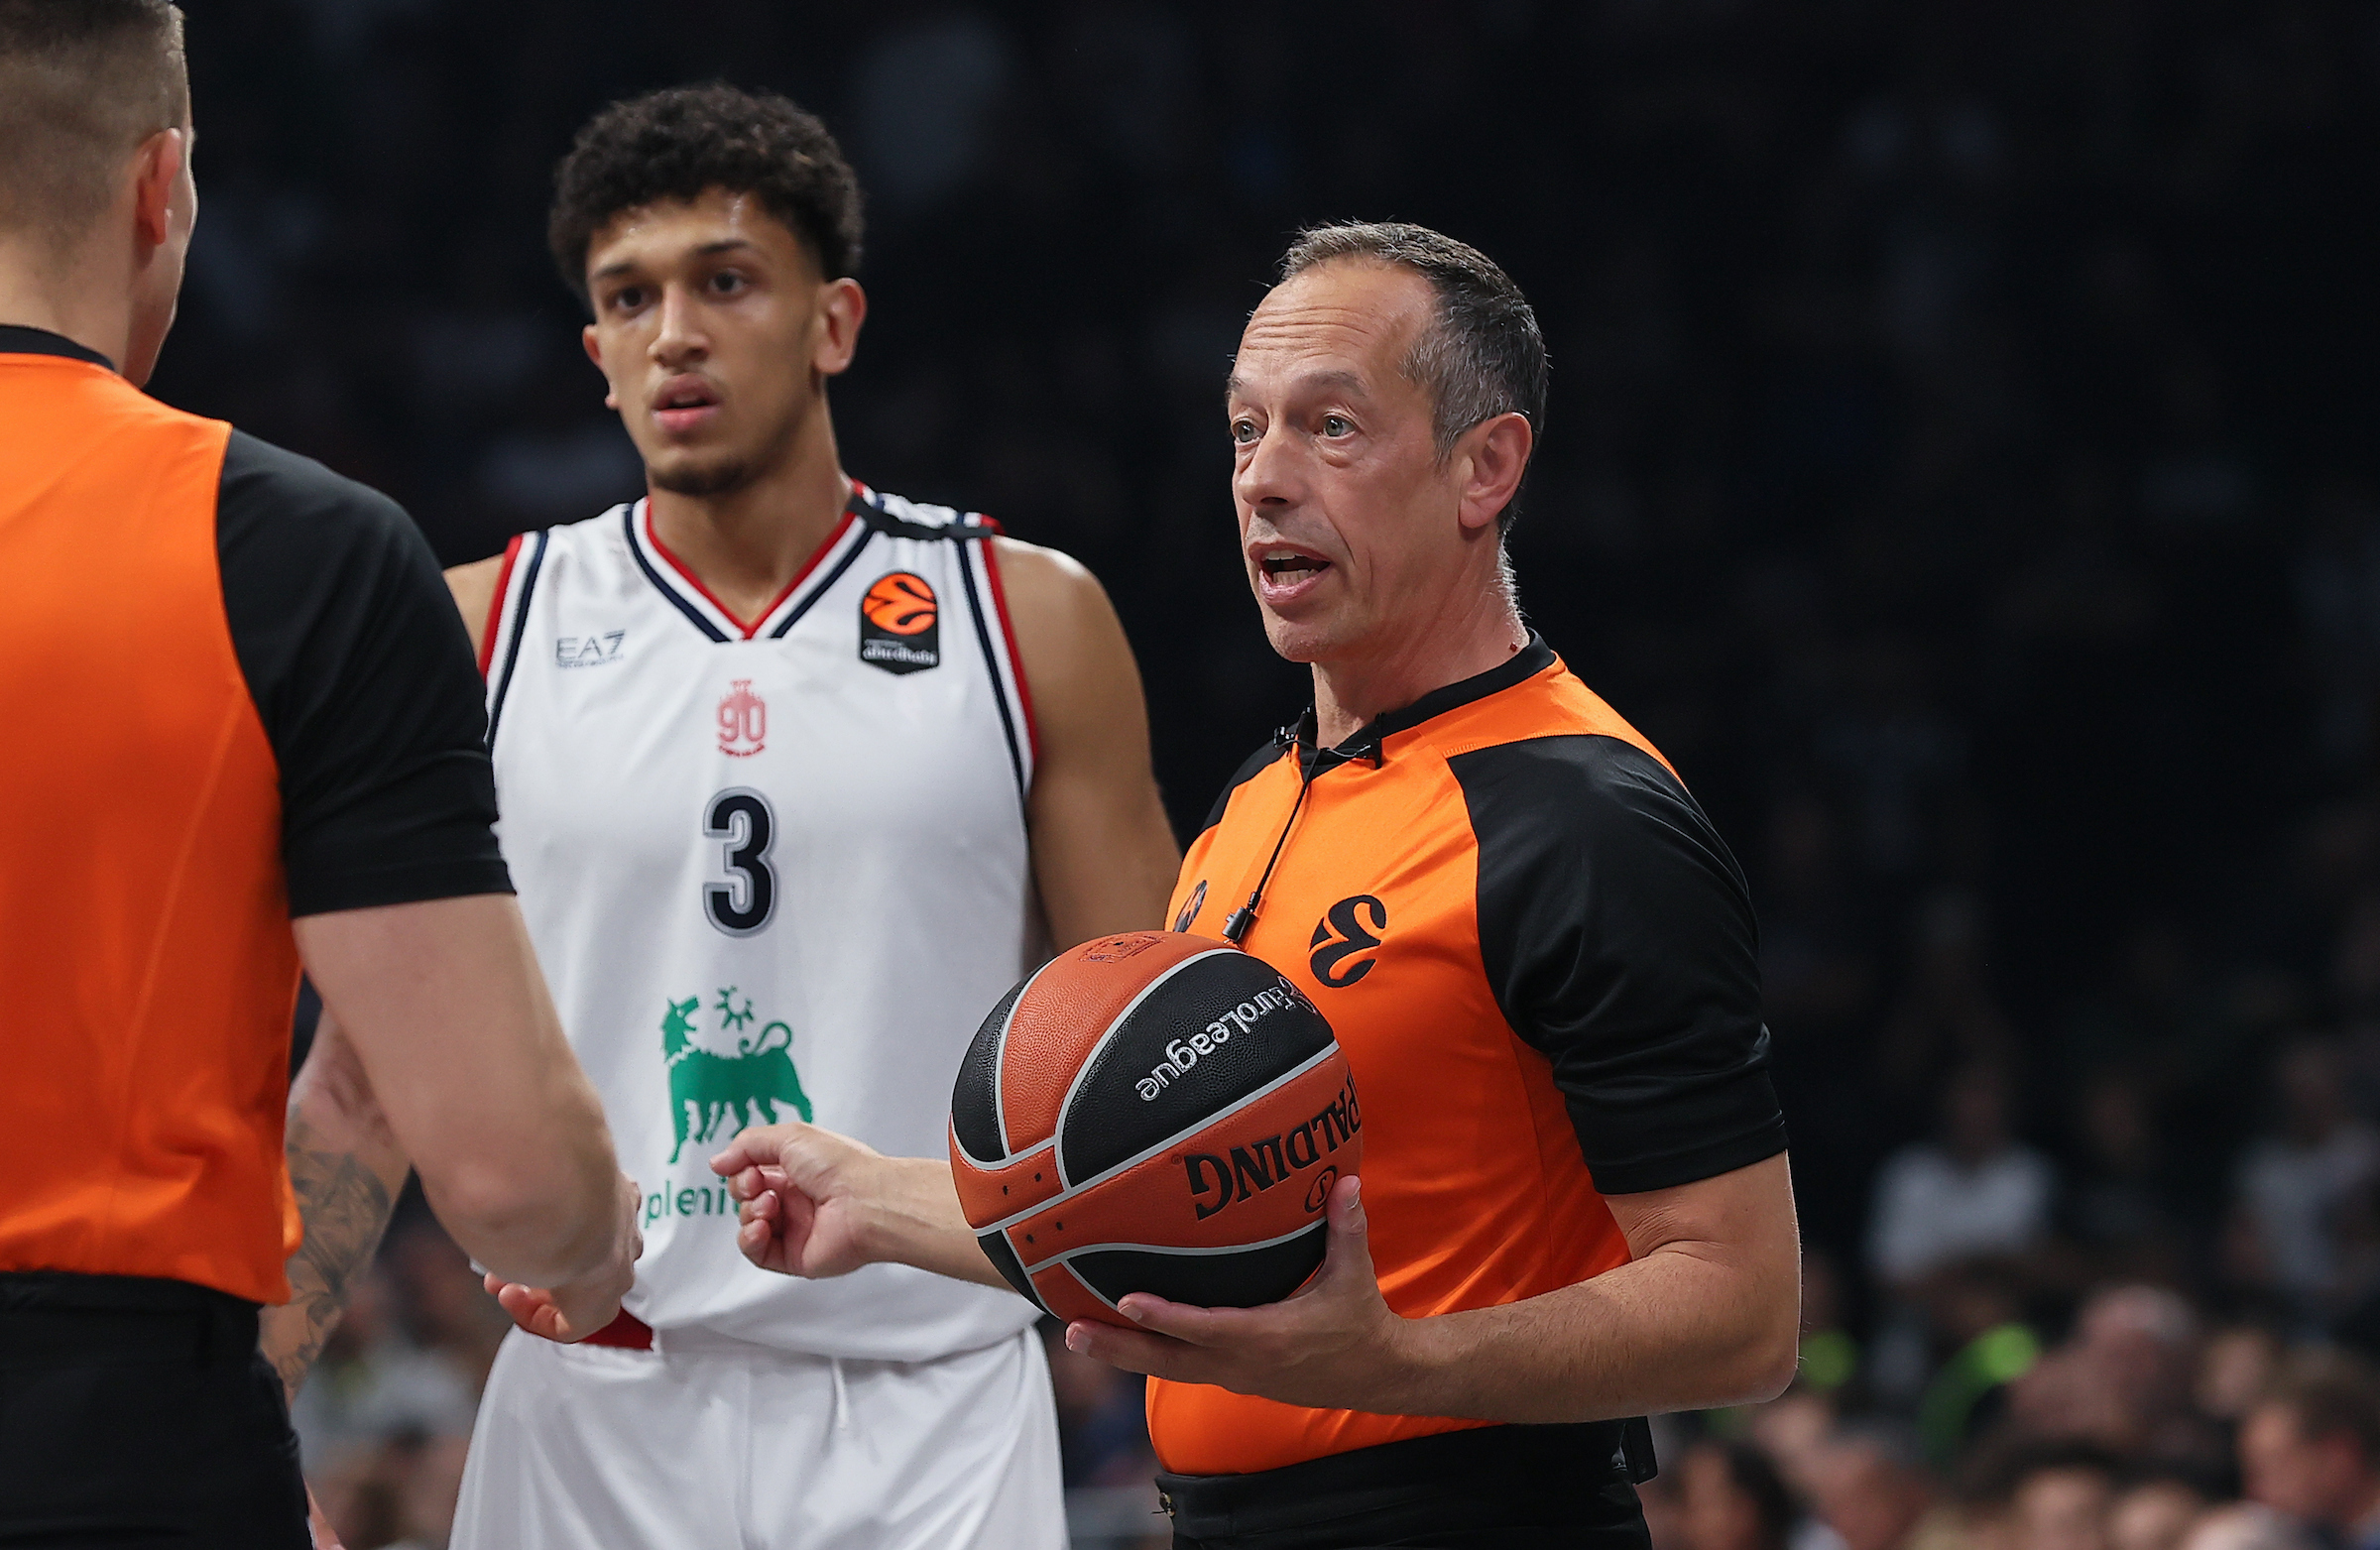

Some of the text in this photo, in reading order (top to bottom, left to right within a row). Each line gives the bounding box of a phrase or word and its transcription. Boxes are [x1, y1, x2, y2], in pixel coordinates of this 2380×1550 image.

[556, 629, 626, 659] EA7
[718, 697, 767, 743] 90
[703, 786, 778, 938] 3
[1134, 986, 1297, 1102] EuroLeague
[1184, 1064, 1362, 1222] PALDING
[645, 1176, 740, 1229] pleni
